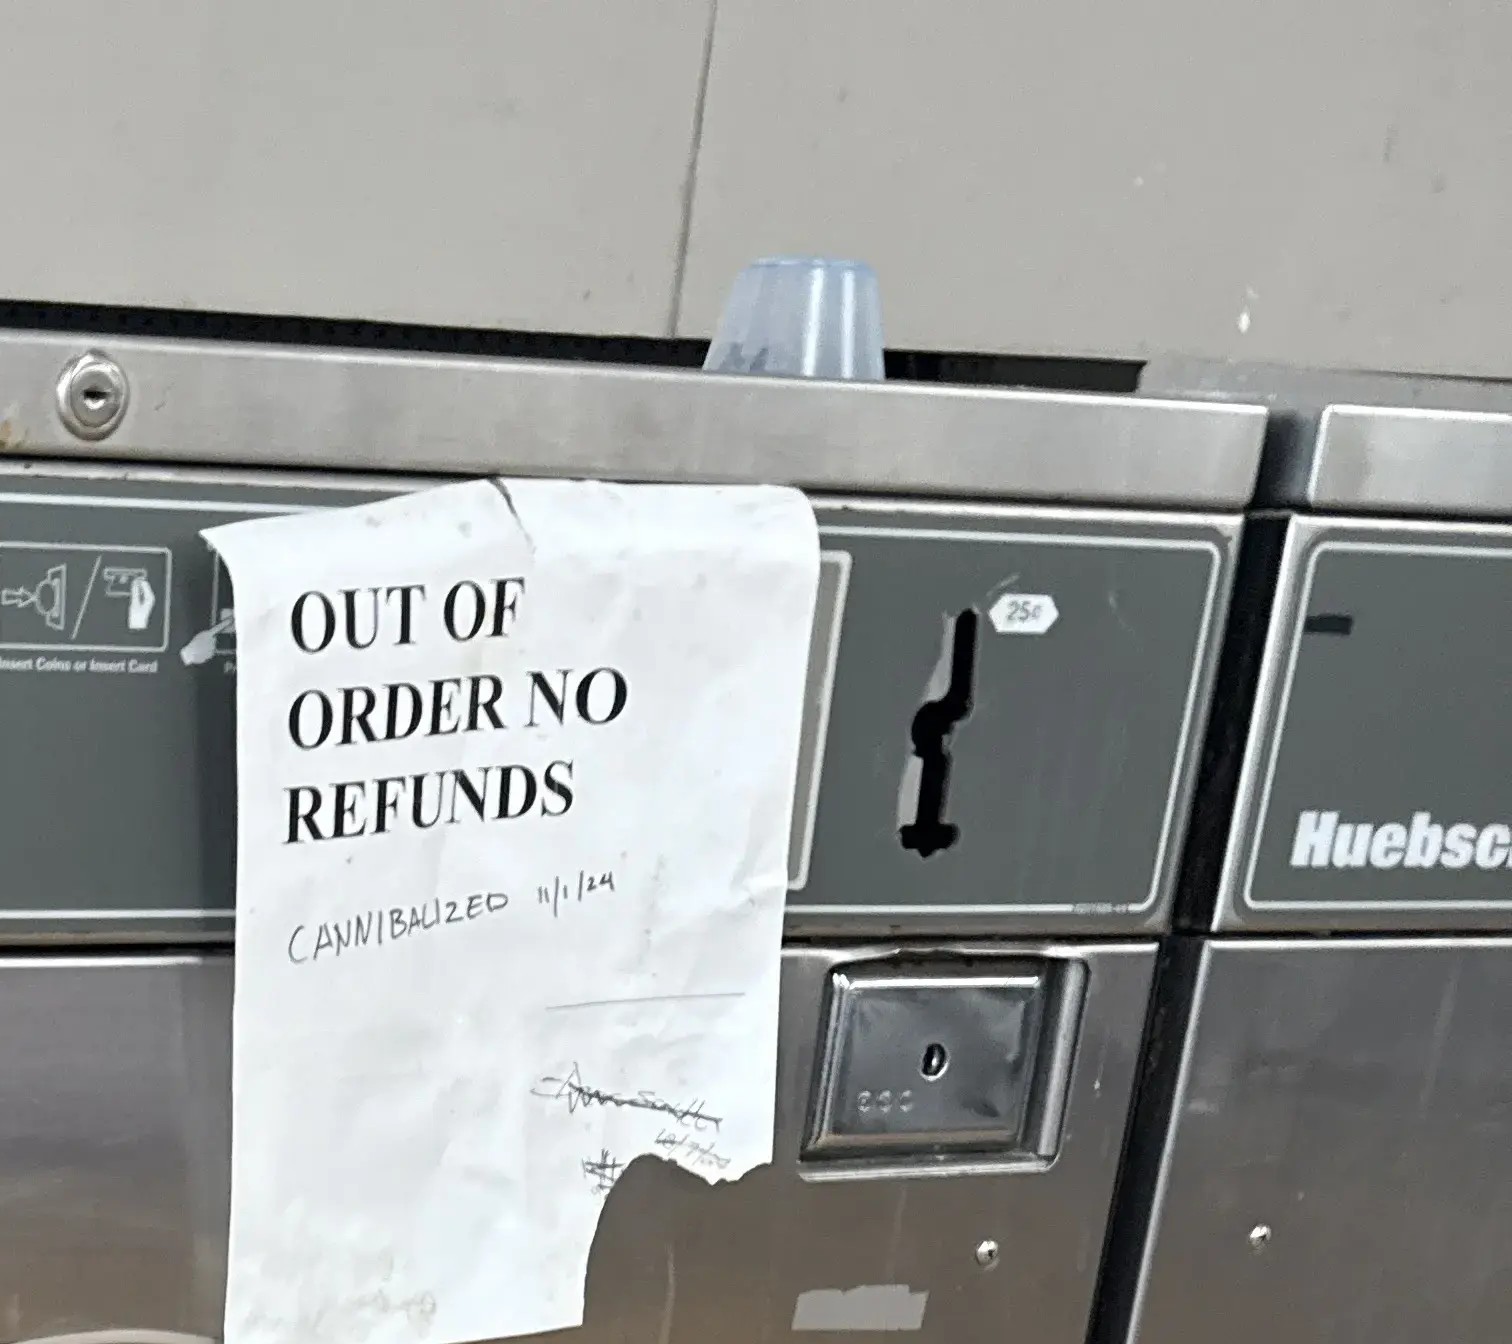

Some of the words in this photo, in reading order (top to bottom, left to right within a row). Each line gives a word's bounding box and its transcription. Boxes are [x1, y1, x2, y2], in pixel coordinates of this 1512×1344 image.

[290, 584, 426, 655] OUT
[443, 576, 526, 643] OF
[36, 656, 71, 672] Coins
[73, 661, 87, 672] or
[89, 657, 126, 673] Insert
[128, 658, 158, 674] Card
[287, 673, 508, 751] ORDER
[523, 666, 628, 728] NO
[282, 759, 575, 846] REFUNDS
[1290, 809, 1512, 869] Huebsc
[288, 892, 509, 964] CANNIBALIZED
[537, 870, 615, 918] 11/1/24
